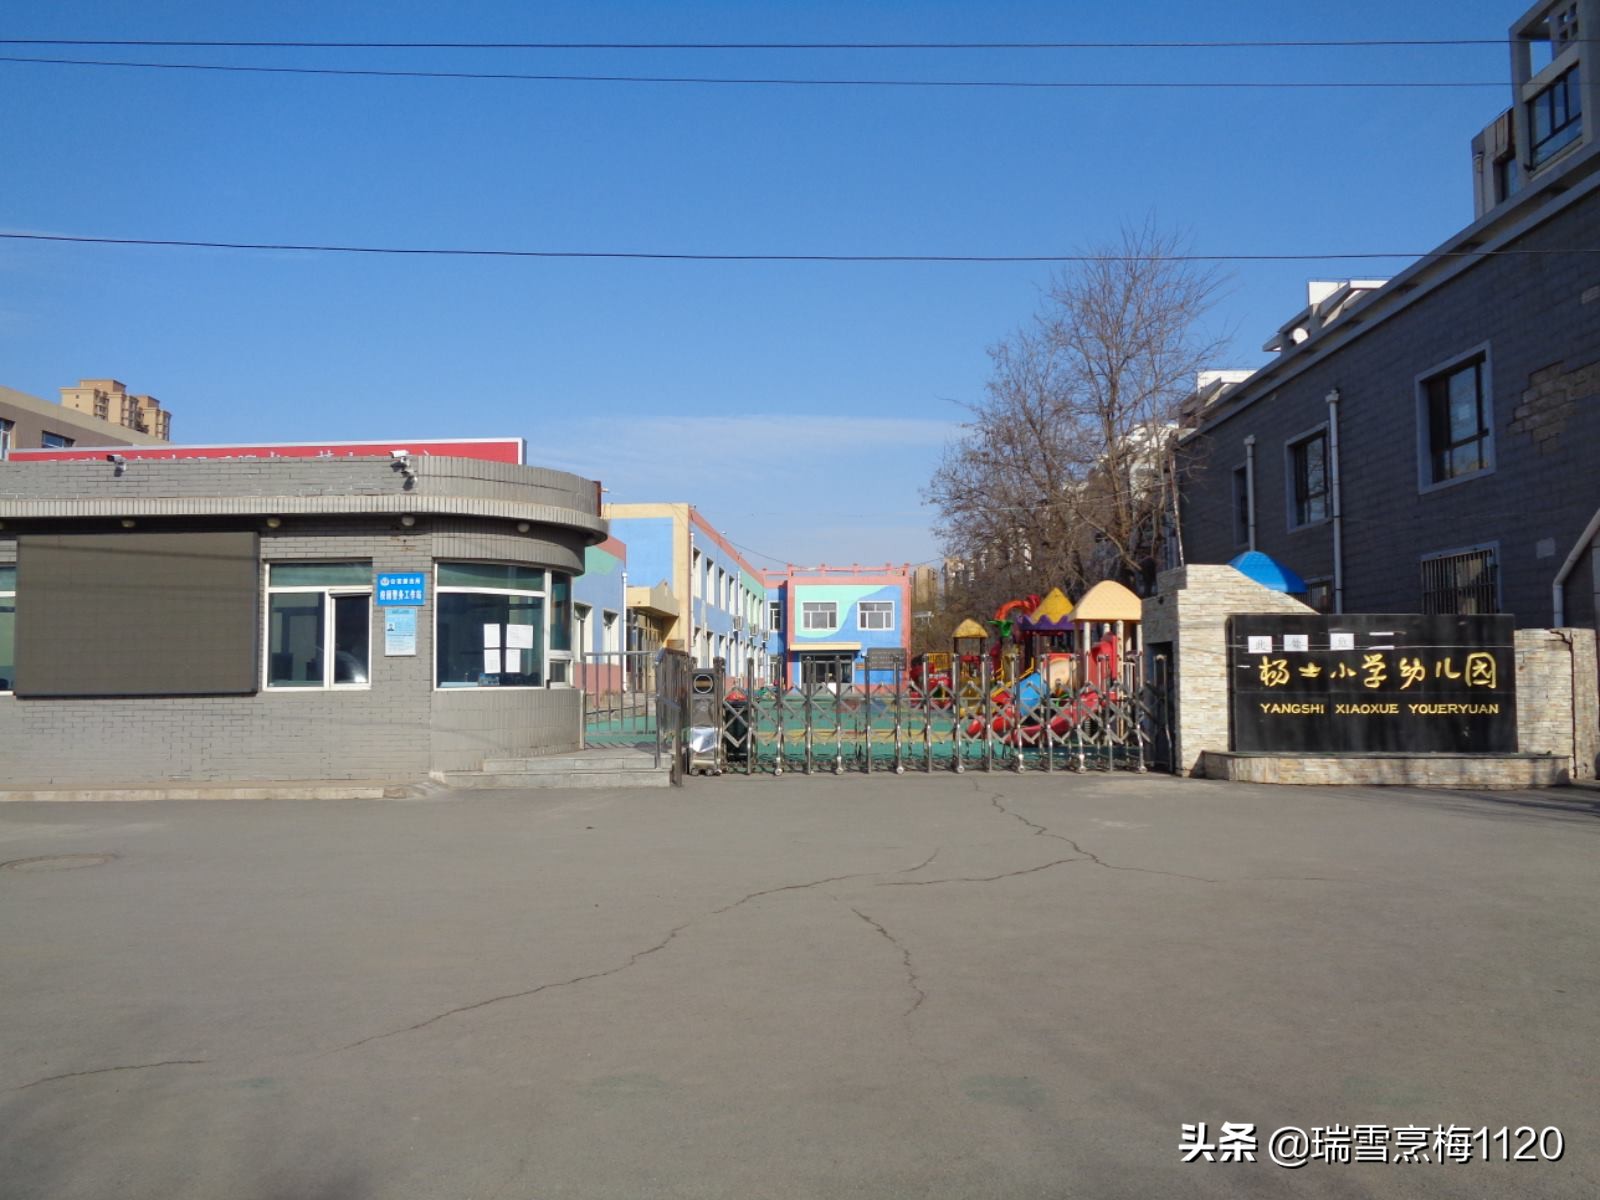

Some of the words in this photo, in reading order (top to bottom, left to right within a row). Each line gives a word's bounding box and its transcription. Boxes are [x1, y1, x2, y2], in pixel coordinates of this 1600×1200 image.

[1259, 652, 1498, 689] 杨士小学幼儿园
[1260, 703, 1325, 715] YANGSHI
[1335, 703, 1400, 715] XIAOXUE
[1409, 703, 1499, 715] YOUERYUAN
